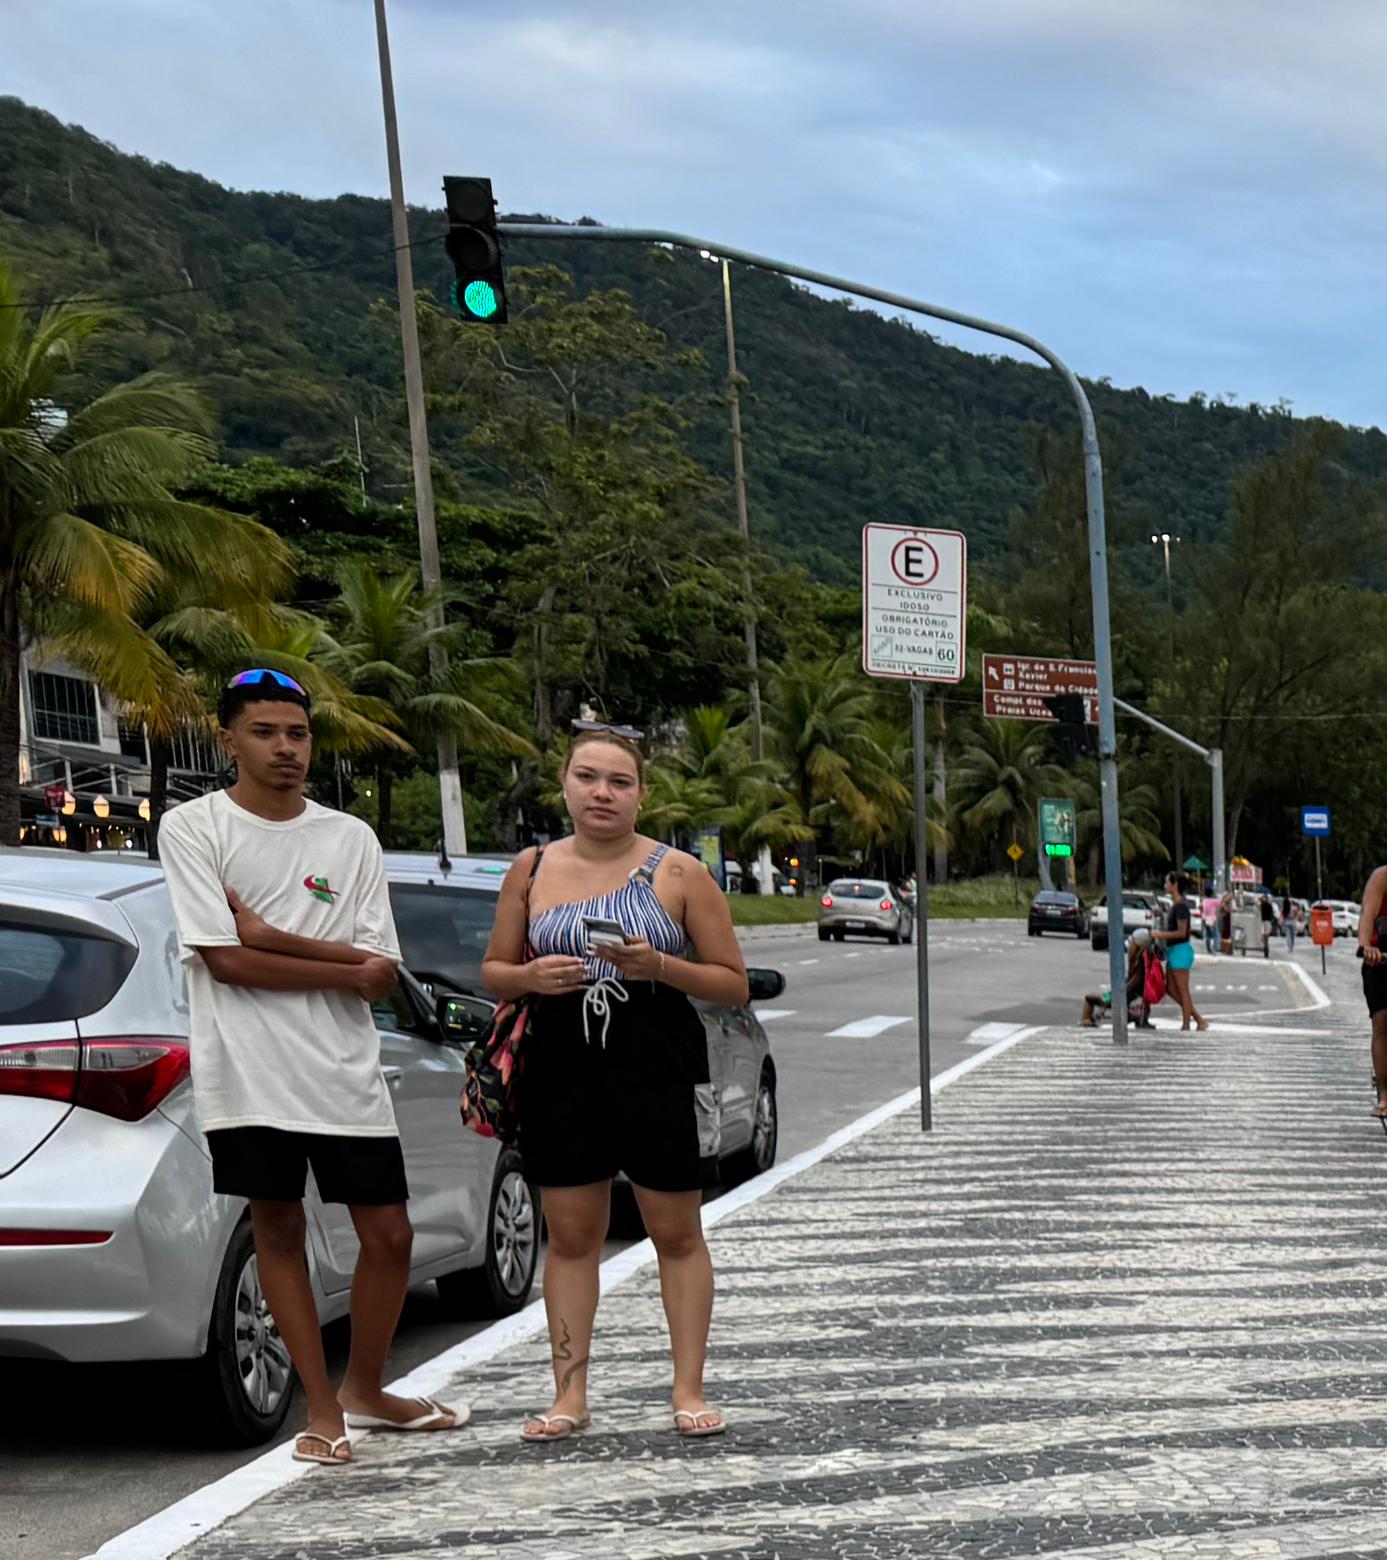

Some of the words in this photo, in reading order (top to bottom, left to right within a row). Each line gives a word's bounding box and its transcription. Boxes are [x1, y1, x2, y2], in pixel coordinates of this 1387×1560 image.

[905, 546, 924, 578] E
[887, 588, 943, 602] EXCLUSIVO
[900, 601, 930, 611] IDOSO
[882, 614, 948, 628] OBRIGATÓRIO
[875, 626, 895, 634] USO
[898, 627, 911, 636] DO
[914, 628, 954, 641] CARTÃO
[937, 648, 955, 661] 60
[1018, 680, 1051, 692] Parque
